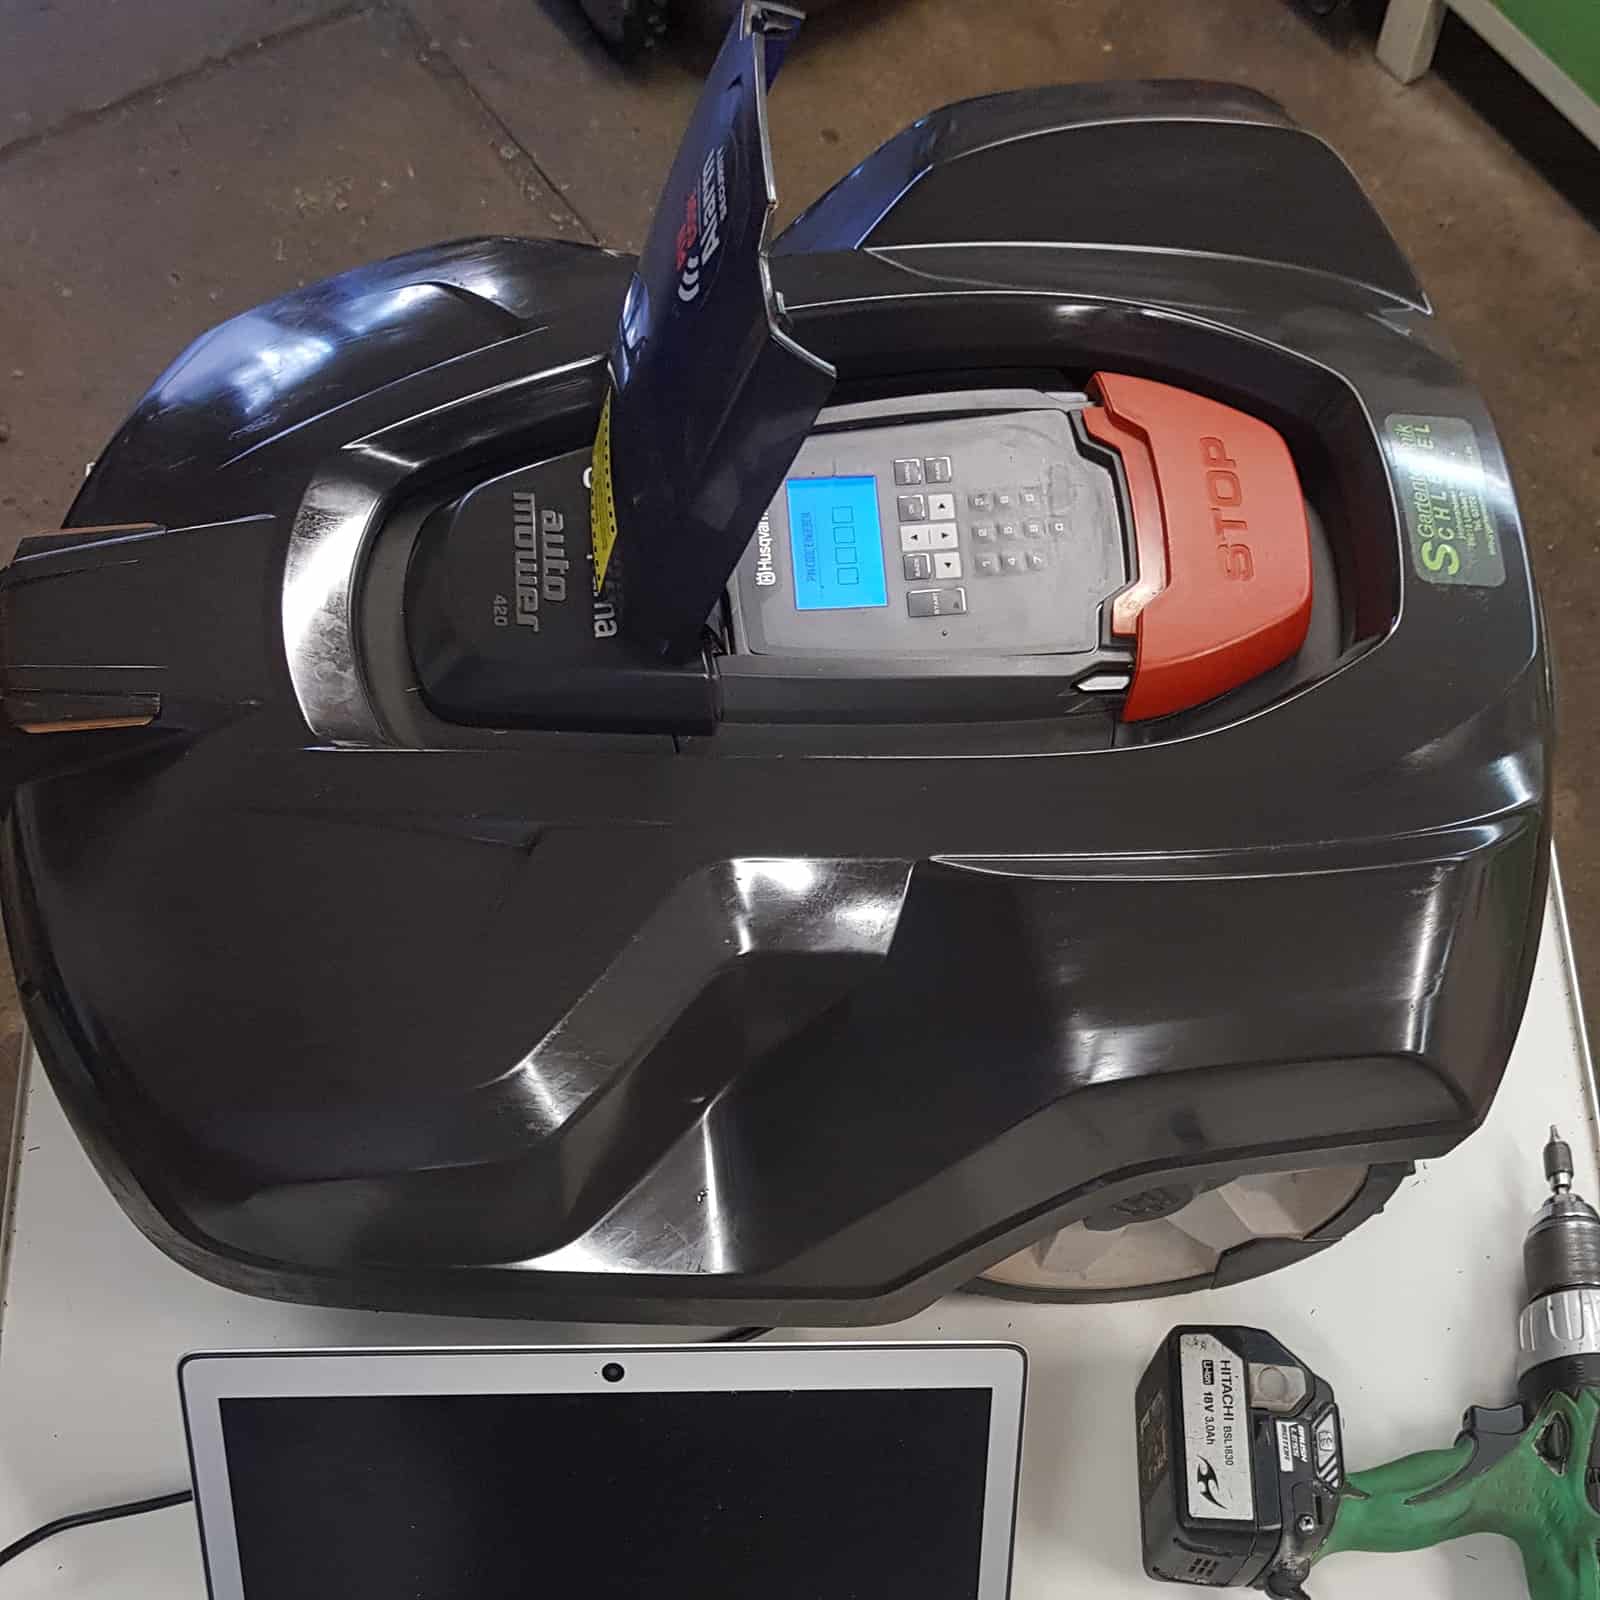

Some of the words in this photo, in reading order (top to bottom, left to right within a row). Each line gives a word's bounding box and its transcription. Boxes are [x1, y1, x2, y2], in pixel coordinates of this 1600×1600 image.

[700, 147, 720, 265] Alarm
[1199, 435, 1254, 581] STOP
[513, 492, 539, 632] mower
[541, 510, 569, 602] auto
[493, 595, 508, 626] 420
[1204, 1392, 1214, 1412] 18V
[1220, 1360, 1234, 1421] HITACHI
[1205, 1416, 1215, 1445] 3.0Ah
